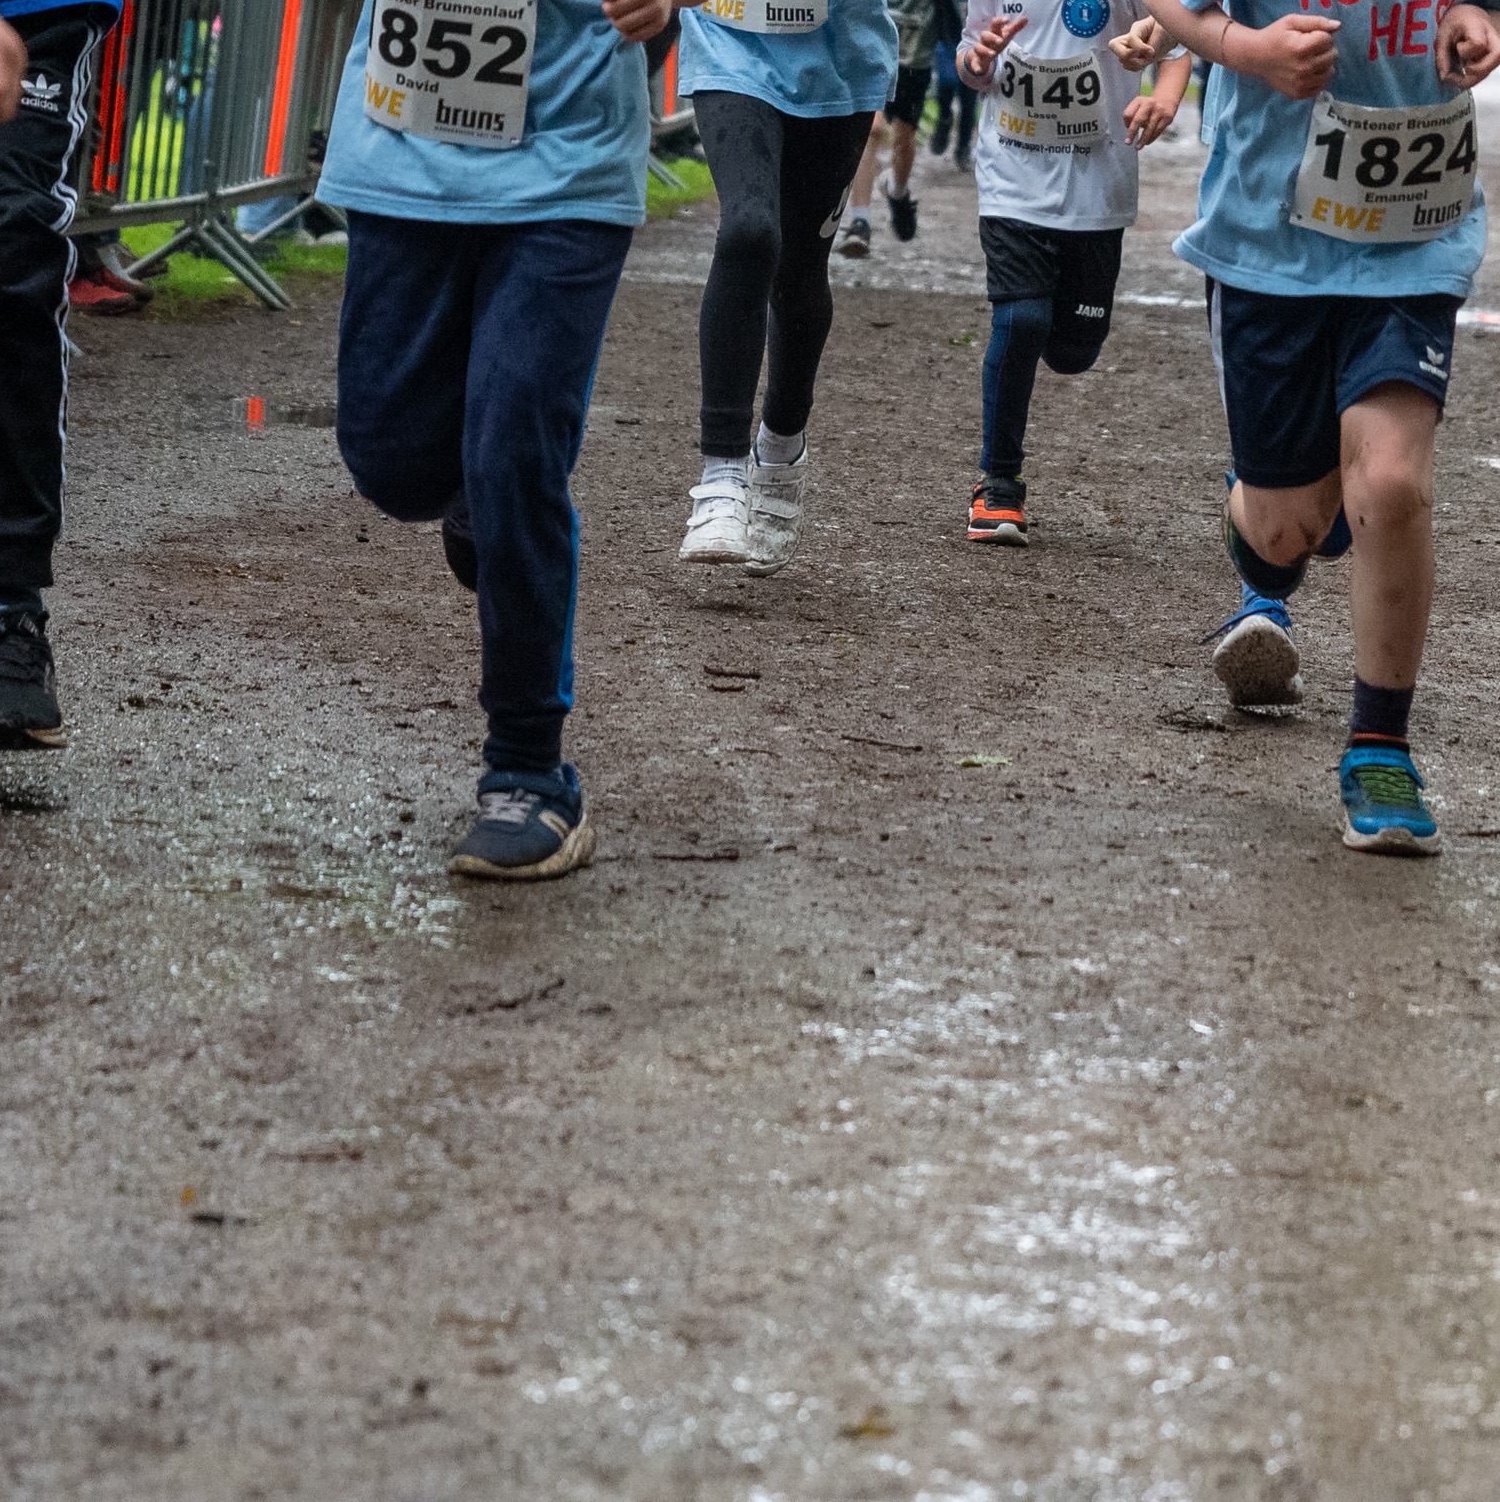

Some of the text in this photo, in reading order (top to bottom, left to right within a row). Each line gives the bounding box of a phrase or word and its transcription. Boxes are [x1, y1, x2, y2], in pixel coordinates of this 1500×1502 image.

[766, 2, 815, 22] bruns
[1038, 57, 1093, 74] Brunnenlauf
[396, 73, 440, 94] David
[1000, 60, 1101, 110] 3149
[21, 97, 59, 112] adidas
[435, 98, 505, 132] bruns
[1000, 110, 1098, 137] EWE bruns
[1027, 110, 1057, 120] Lasse
[1315, 119, 1476, 188] 1824
[1364, 189, 1428, 204] Emanuel
[1312, 196, 1386, 232] EWE
[1413, 199, 1463, 227] bruns
[1075, 303, 1104, 318] JAKO
